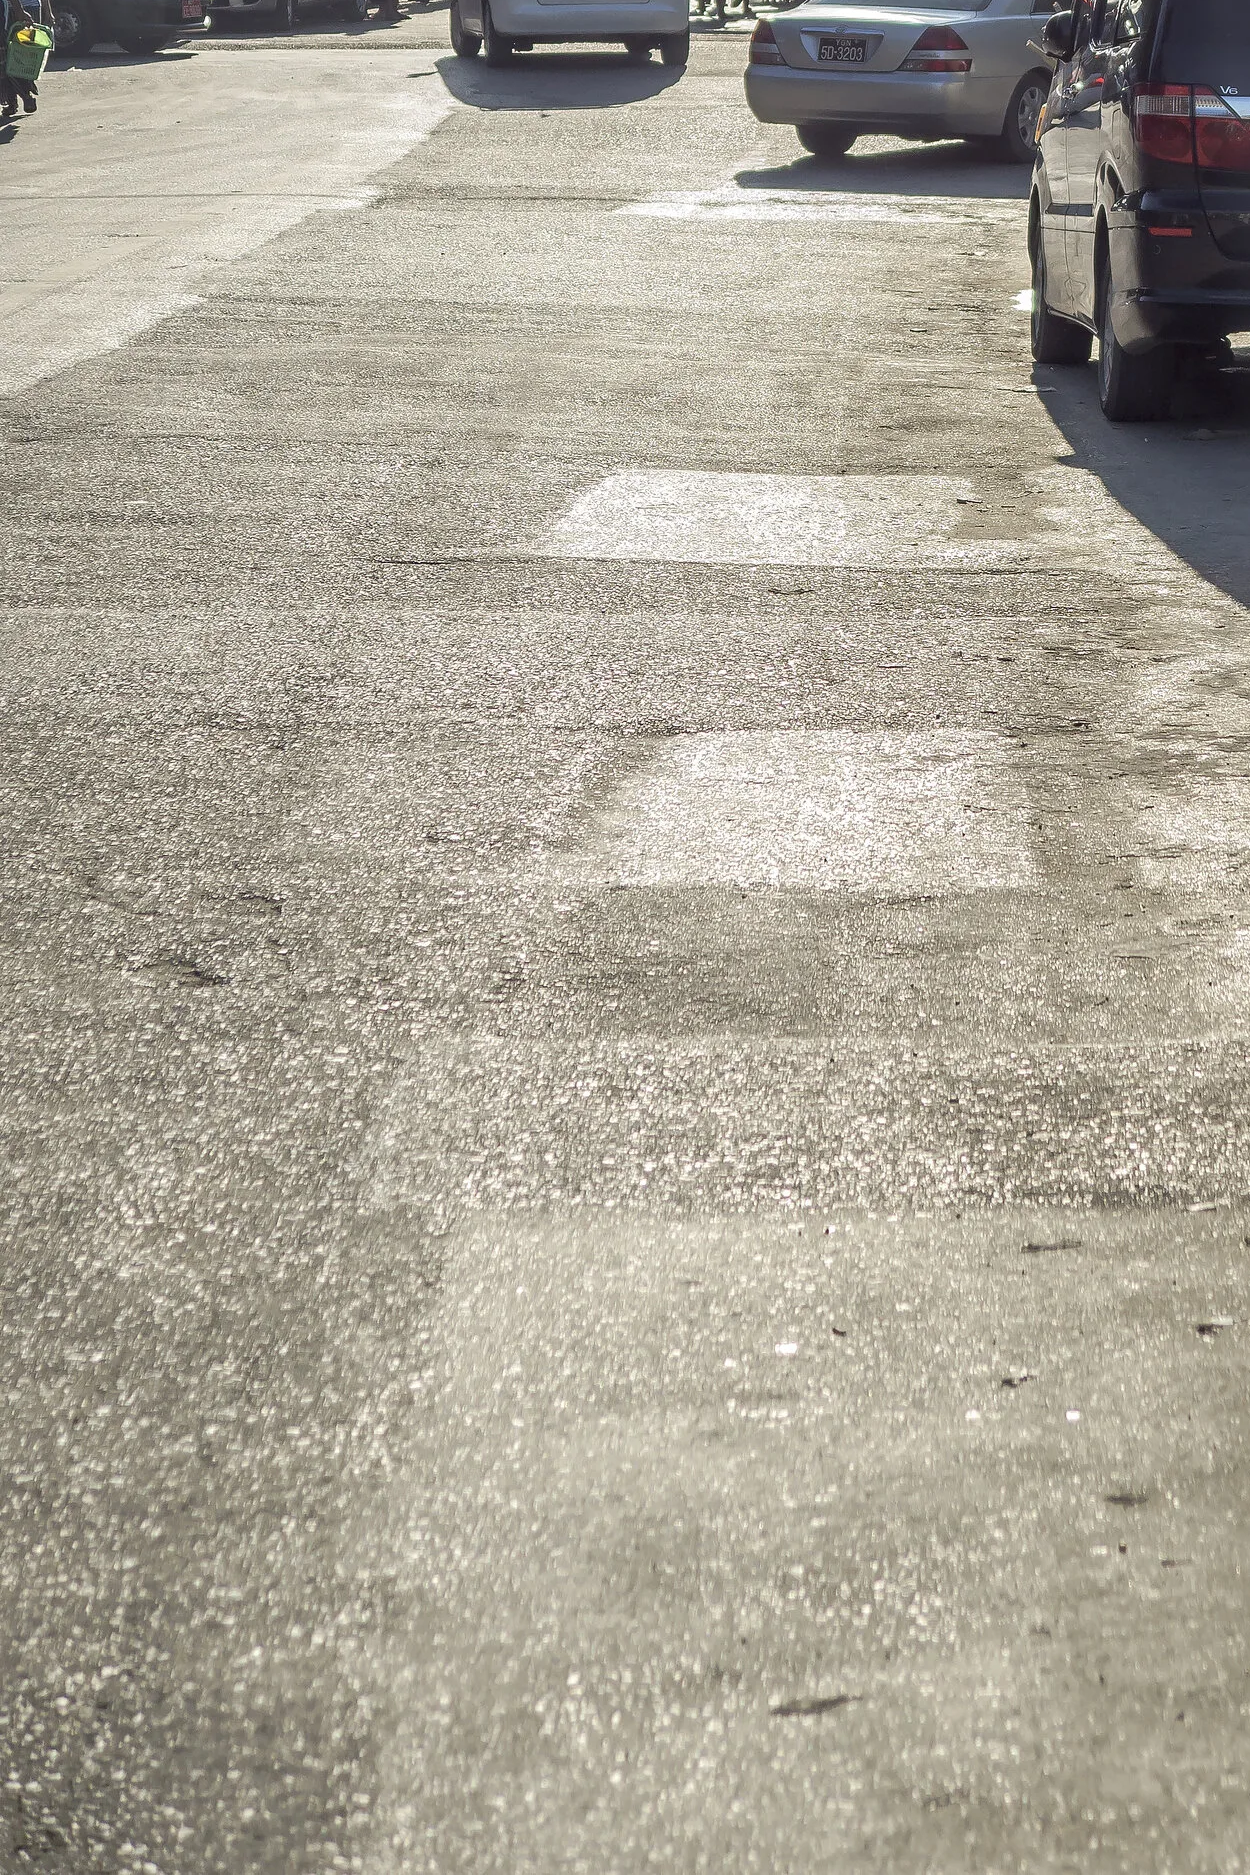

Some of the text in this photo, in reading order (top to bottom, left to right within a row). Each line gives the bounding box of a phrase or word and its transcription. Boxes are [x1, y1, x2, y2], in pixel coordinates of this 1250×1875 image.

[835, 39, 852, 47] YGN
[820, 45, 864, 62] 5D-3203
[1219, 85, 1239, 95] V6
